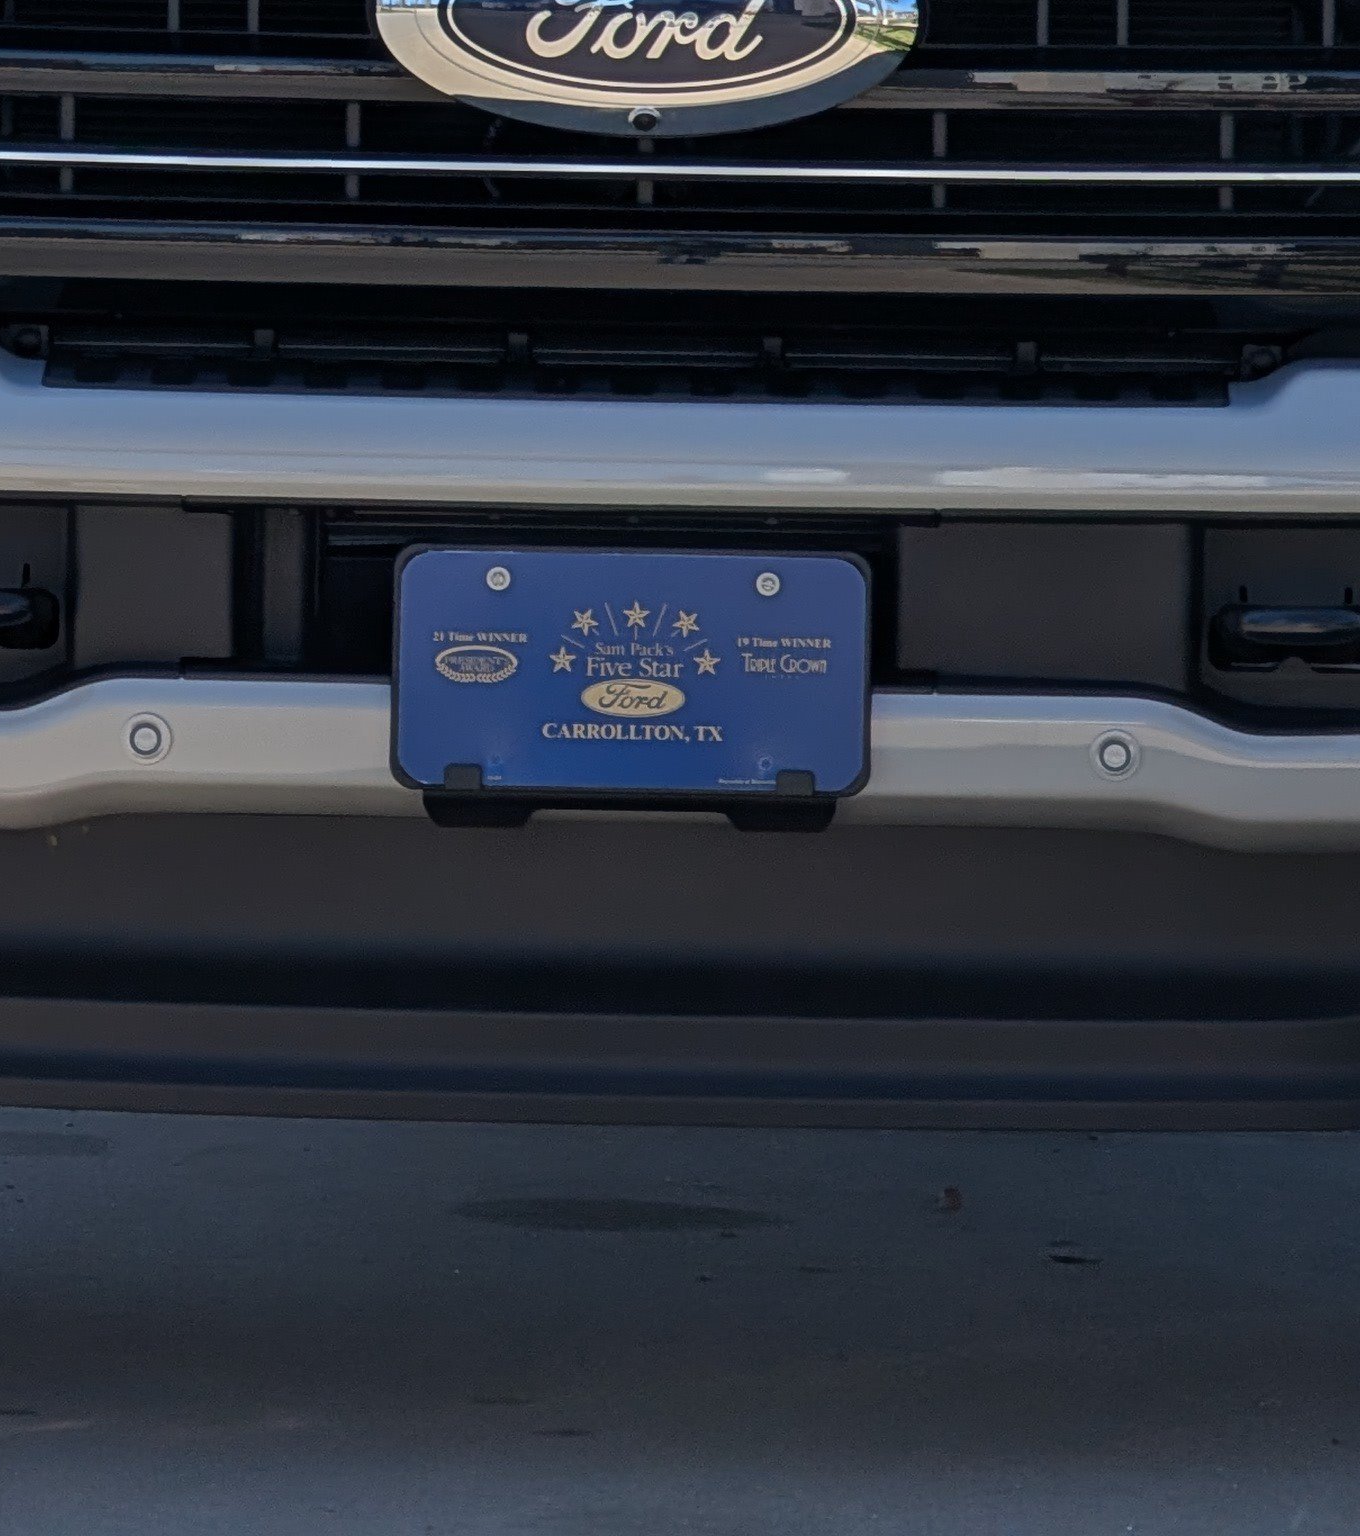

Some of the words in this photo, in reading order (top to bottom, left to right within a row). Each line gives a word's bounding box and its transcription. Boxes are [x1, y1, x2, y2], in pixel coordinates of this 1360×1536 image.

[448, 631, 474, 642] Time
[477, 631, 528, 643] WINNER
[752, 637, 778, 648] Time
[780, 637, 832, 649] WINNER
[595, 641, 625, 656] Sam
[630, 642, 674, 657] Pack's
[586, 657, 633, 677] Five
[640, 657, 684, 678] Star
[598, 682, 669, 710] Ford
[542, 722, 690, 743] CARROLLTON,
[694, 725, 723, 742] TX
